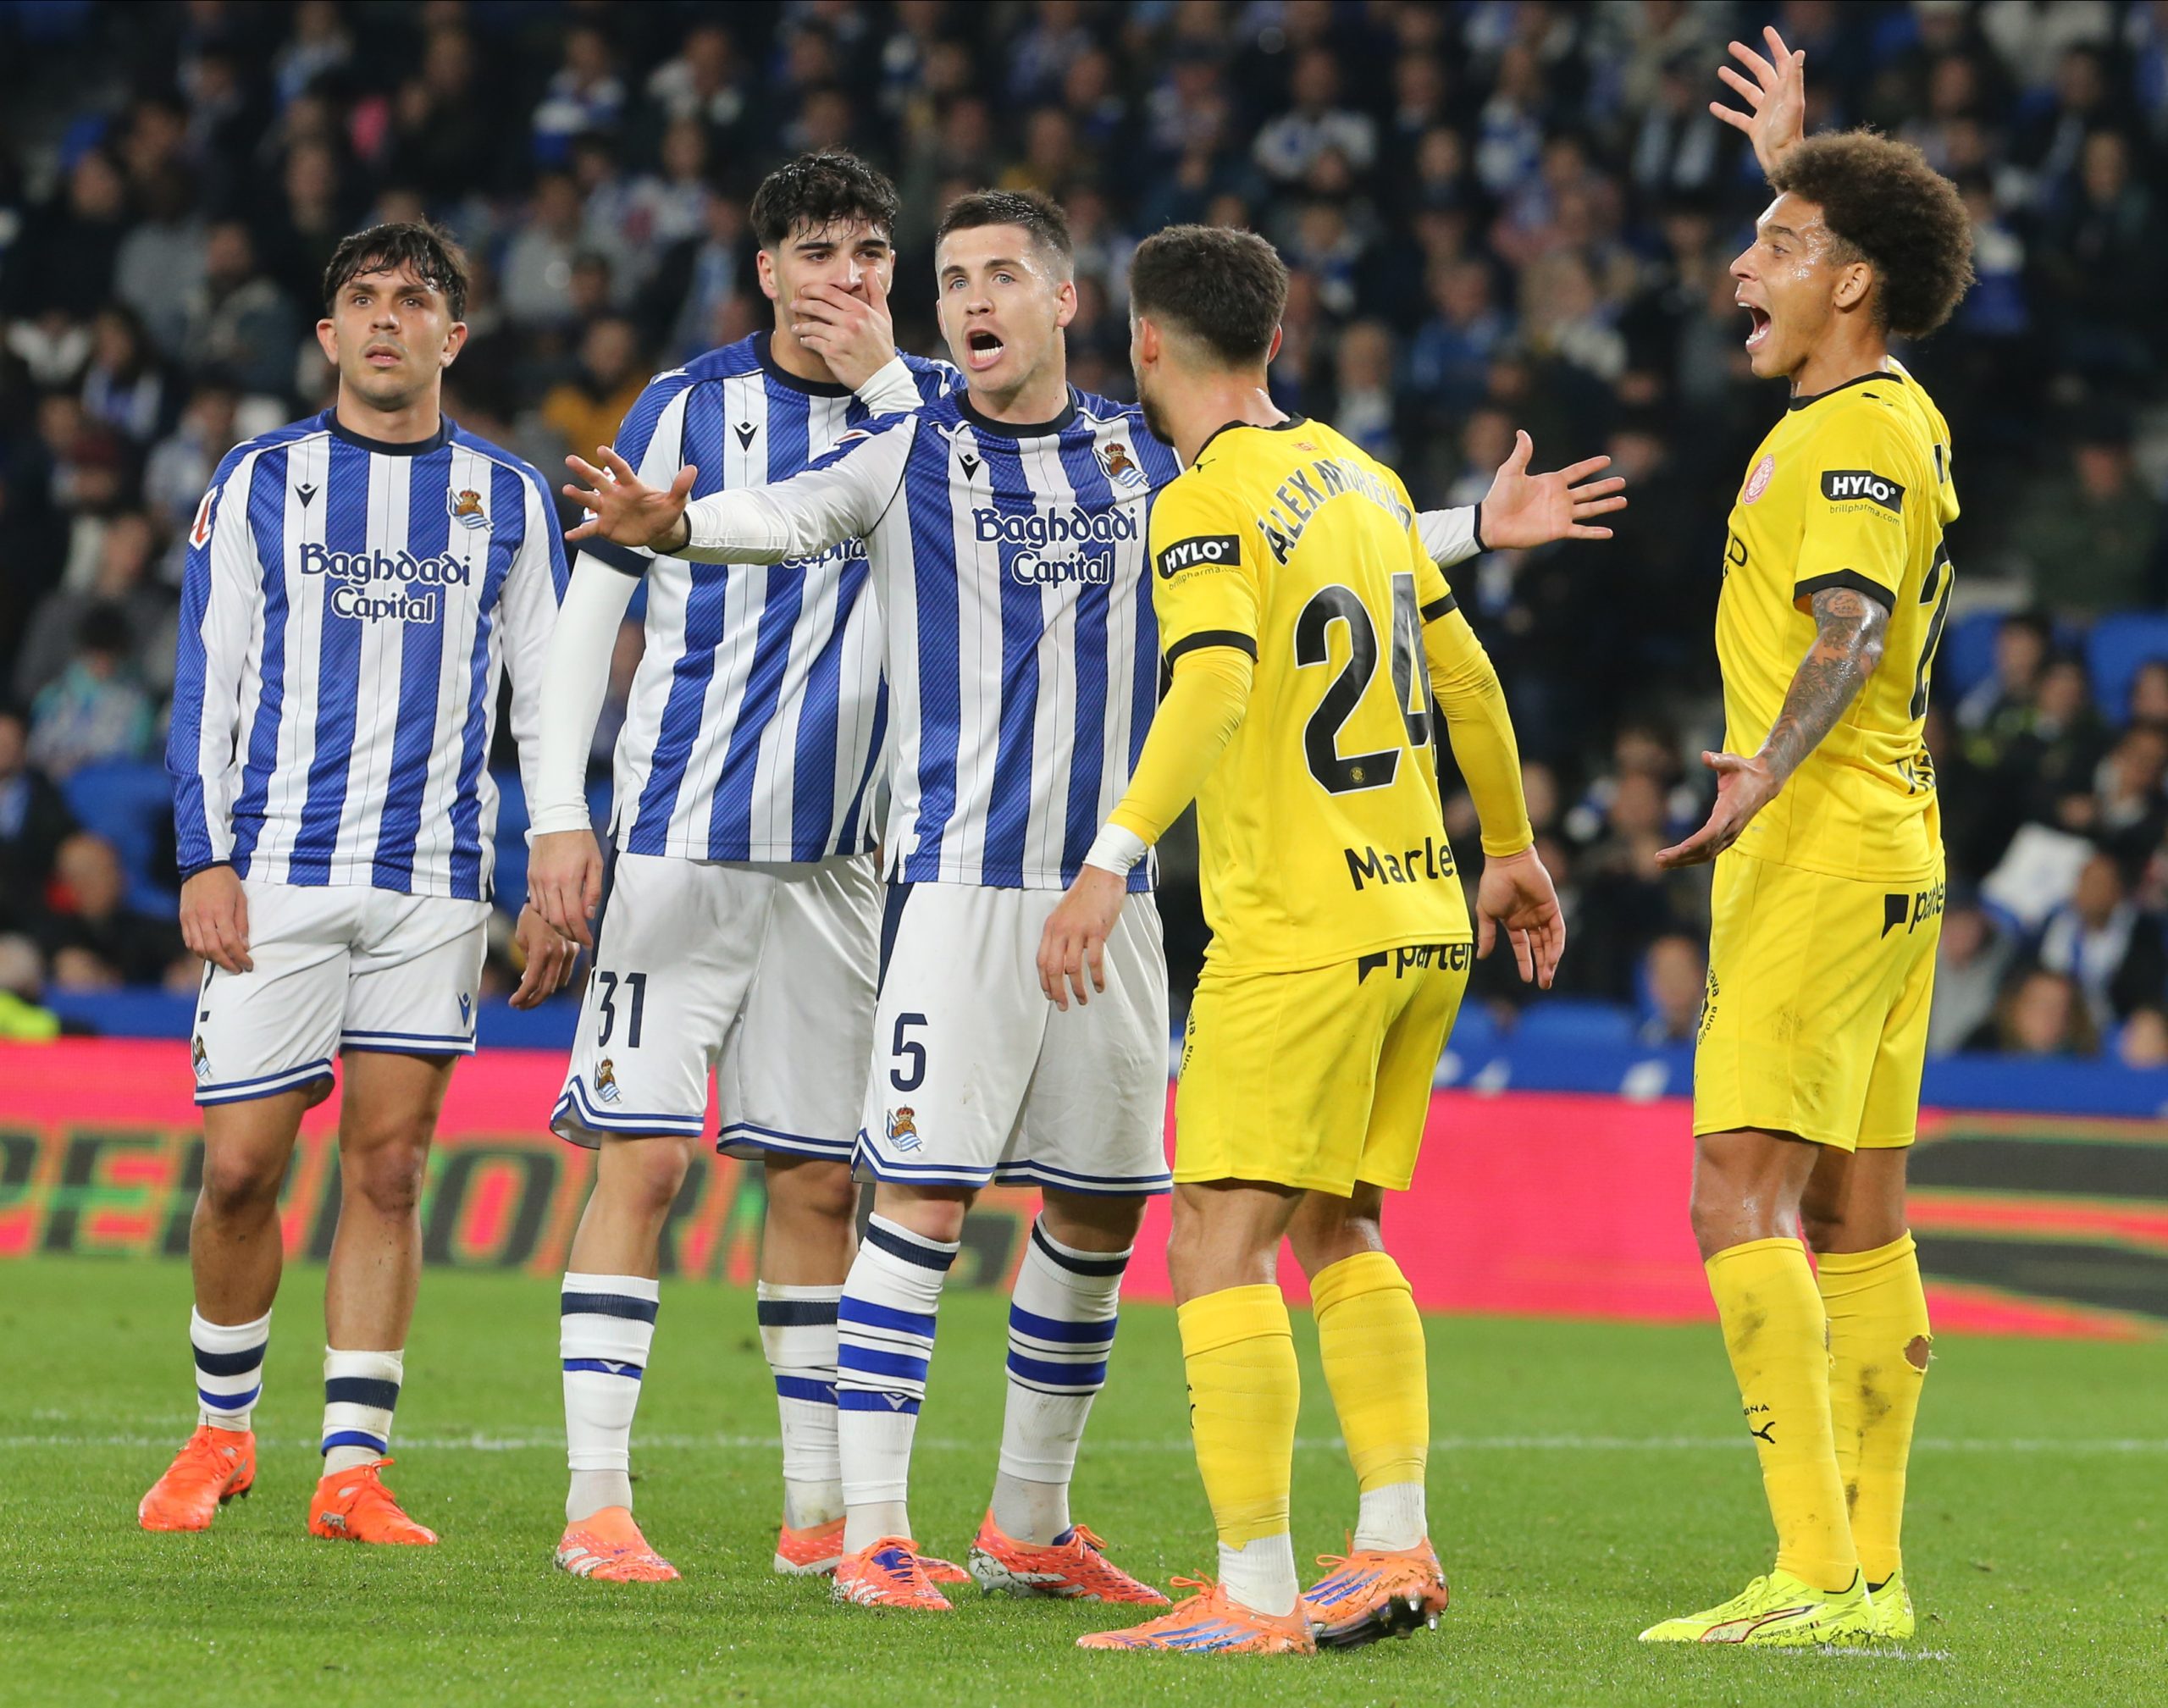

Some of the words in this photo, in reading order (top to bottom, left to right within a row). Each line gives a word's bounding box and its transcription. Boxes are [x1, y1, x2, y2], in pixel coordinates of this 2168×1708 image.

[972, 507, 1138, 550] Baghdadi
[1829, 503, 1900, 527] brillpharma.com
[299, 543, 472, 586] Baghdadi
[1011, 550, 1114, 589] Capital
[331, 587, 436, 624] Capital
[1293, 572, 1438, 797] 24
[1344, 836, 1458, 892] Marle
[598, 970, 648, 1049] 31
[889, 1012, 928, 1092] 5
